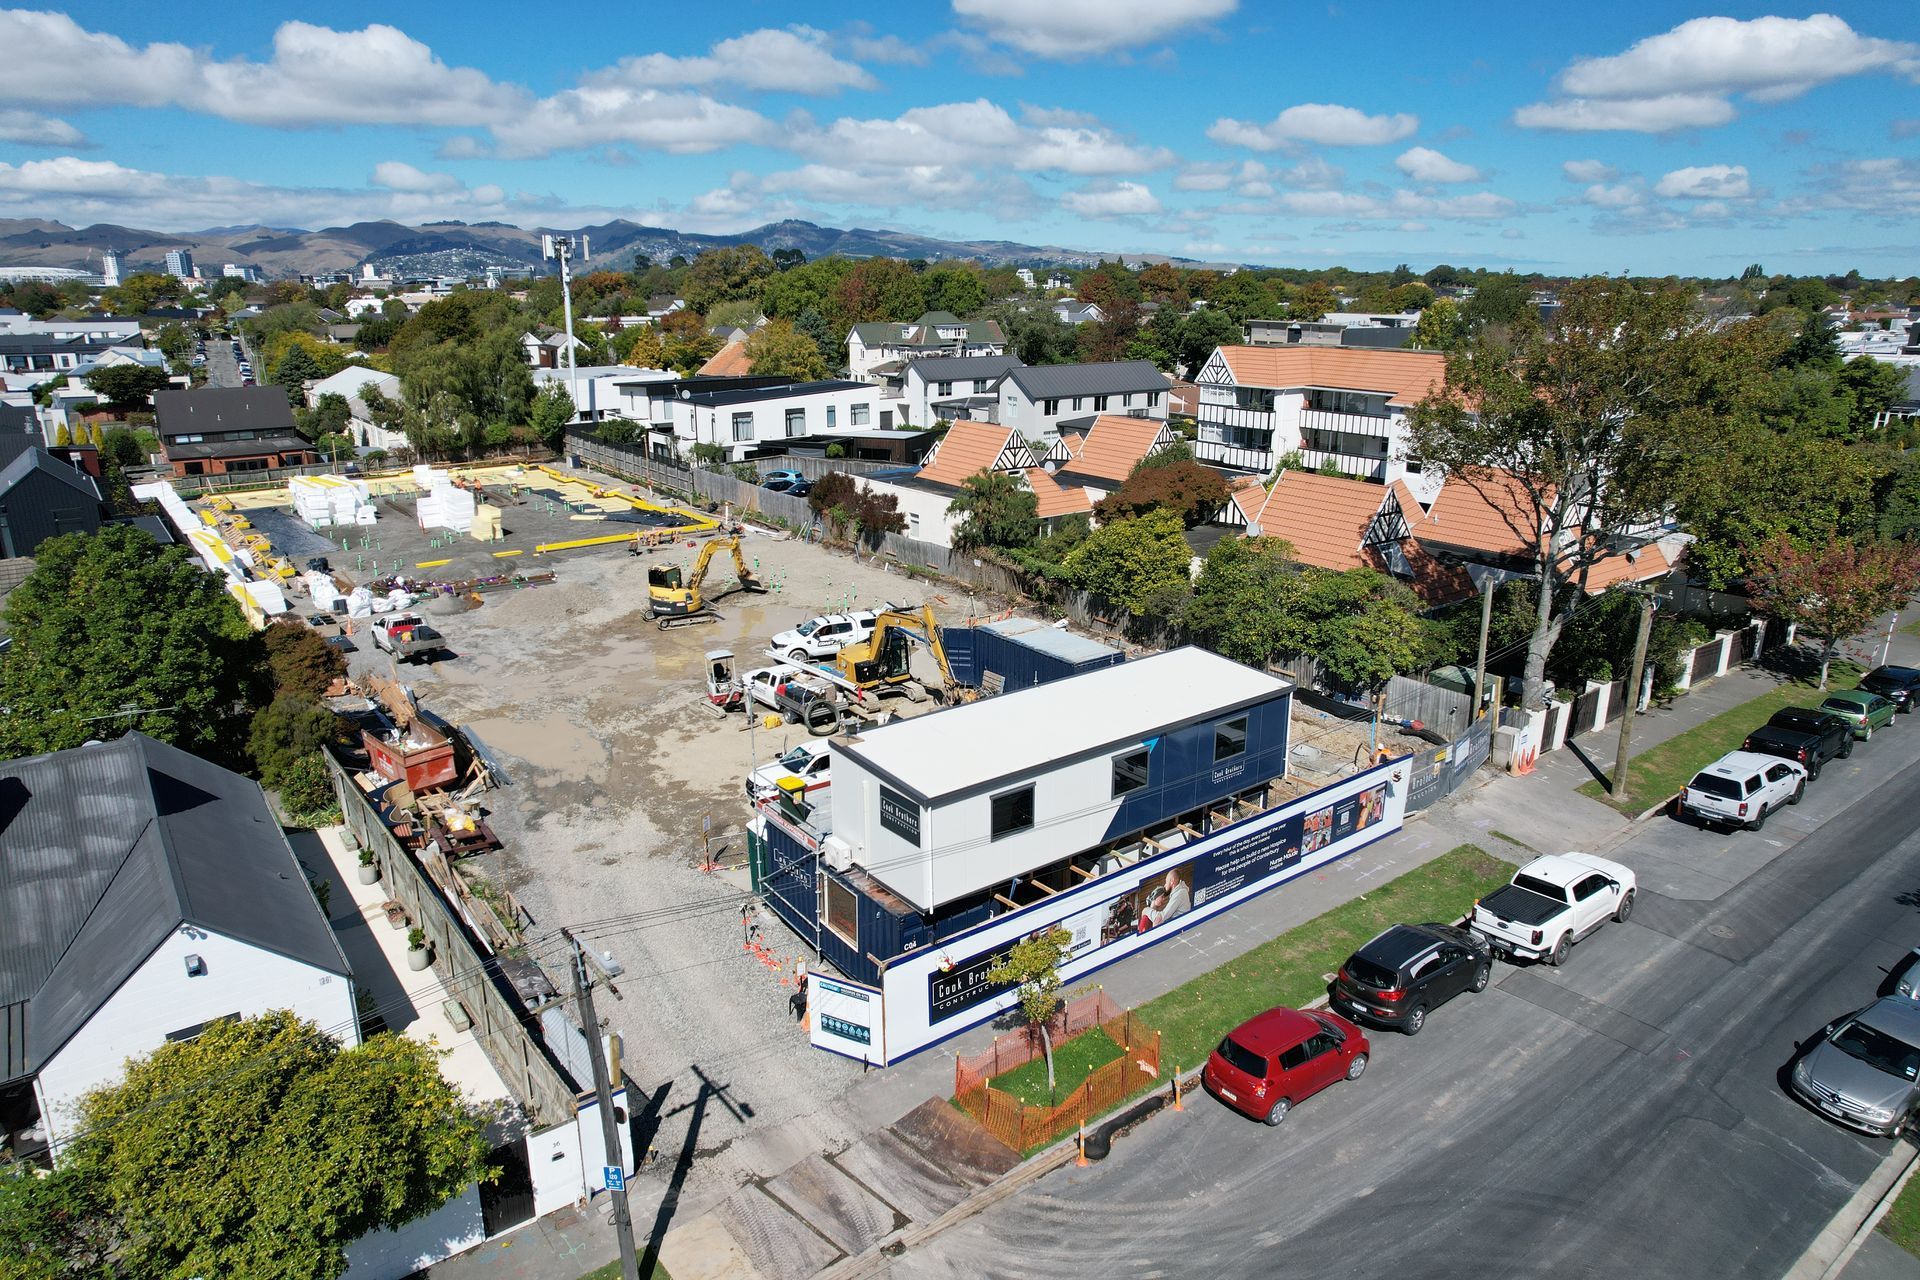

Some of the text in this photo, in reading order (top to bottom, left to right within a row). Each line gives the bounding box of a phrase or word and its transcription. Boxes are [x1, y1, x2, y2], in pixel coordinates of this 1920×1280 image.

[883, 800, 917, 827] Cook Brothers
[883, 812, 917, 835] CONSTRUCTION
[1215, 863, 1229, 872] Please
[1246, 850, 1256, 859] build
[1270, 838, 1286, 849] Hospice
[1236, 860, 1250, 871] people
[1257, 848, 1279, 861] Canterbury
[1269, 856, 1283, 866] Nurse
[939, 978, 962, 998] Cook
